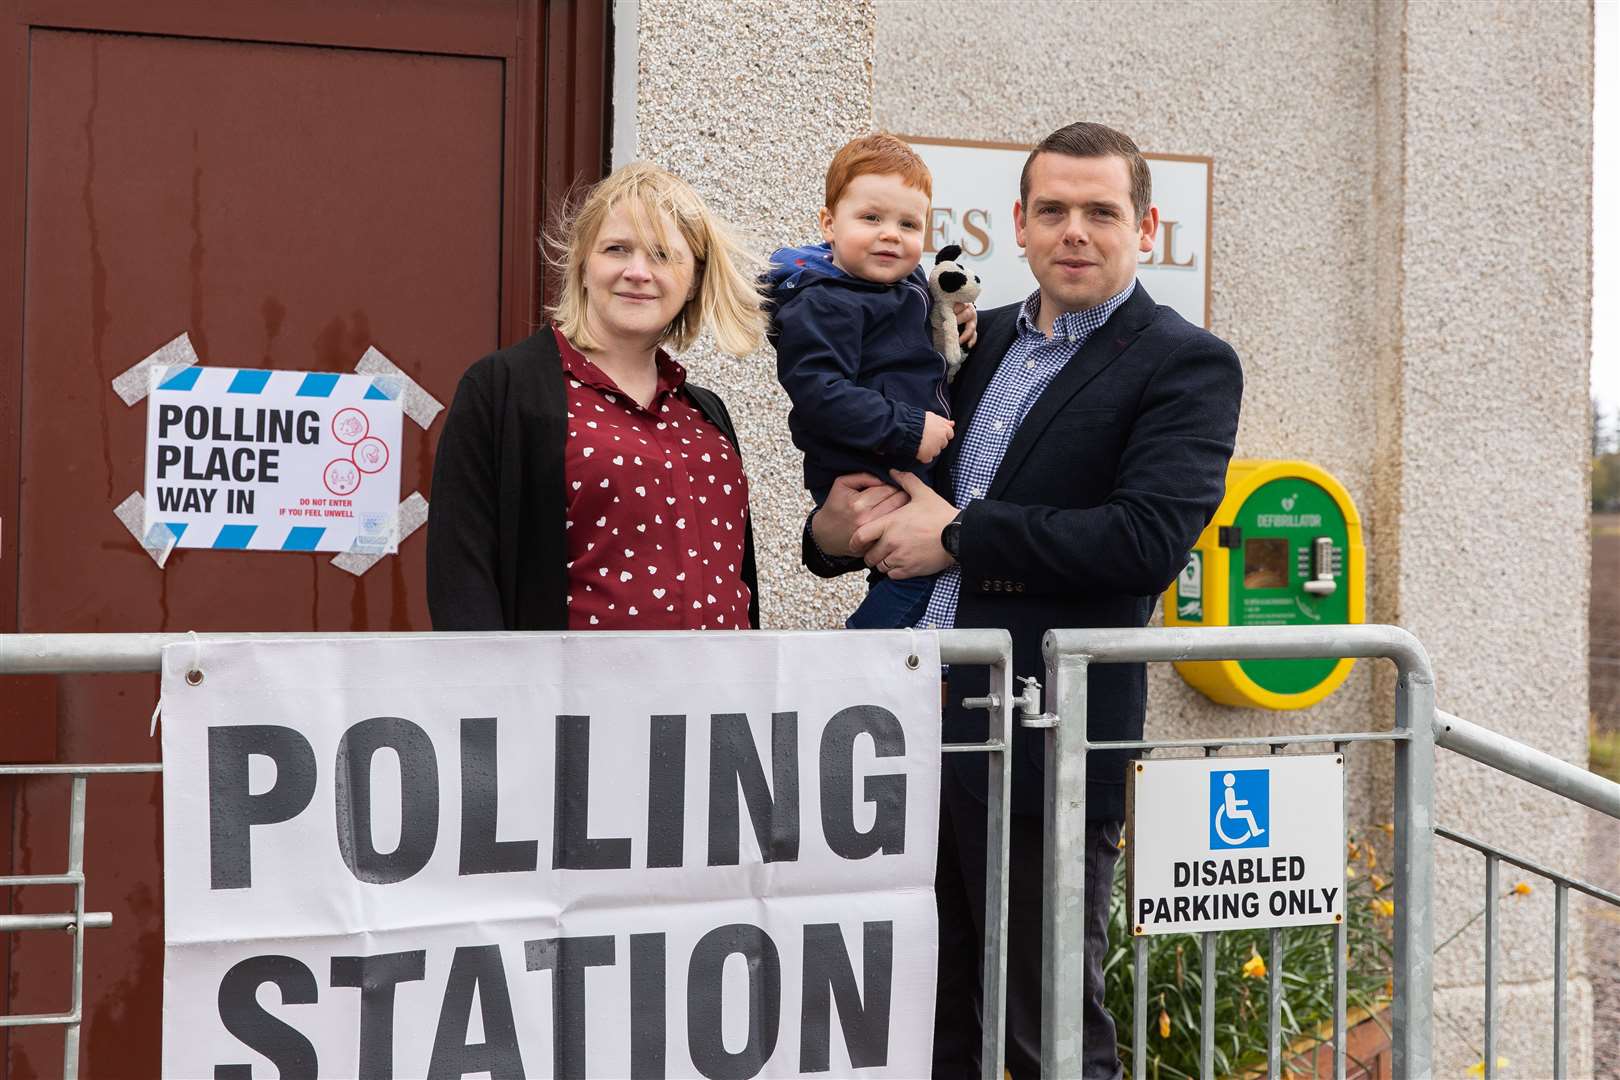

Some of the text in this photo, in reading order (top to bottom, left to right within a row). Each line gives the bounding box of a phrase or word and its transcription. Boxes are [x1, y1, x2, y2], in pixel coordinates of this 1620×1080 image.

[158, 404, 320, 444] POLLING
[157, 445, 280, 483] PLACE
[157, 487, 255, 515] WAY IN
[288, 508, 302, 516] YOU
[304, 509, 321, 517] FEEL
[324, 509, 353, 518] UNWELL
[300, 498, 352, 507] DO NOT ENTER
[1257, 514, 1321, 527] DEFIBRILLATOR
[208, 704, 907, 890] POLLING
[1173, 856, 1305, 888] DISABLED
[1139, 887, 1338, 925] PARKING ONLY
[213, 920, 893, 1080] STATION
